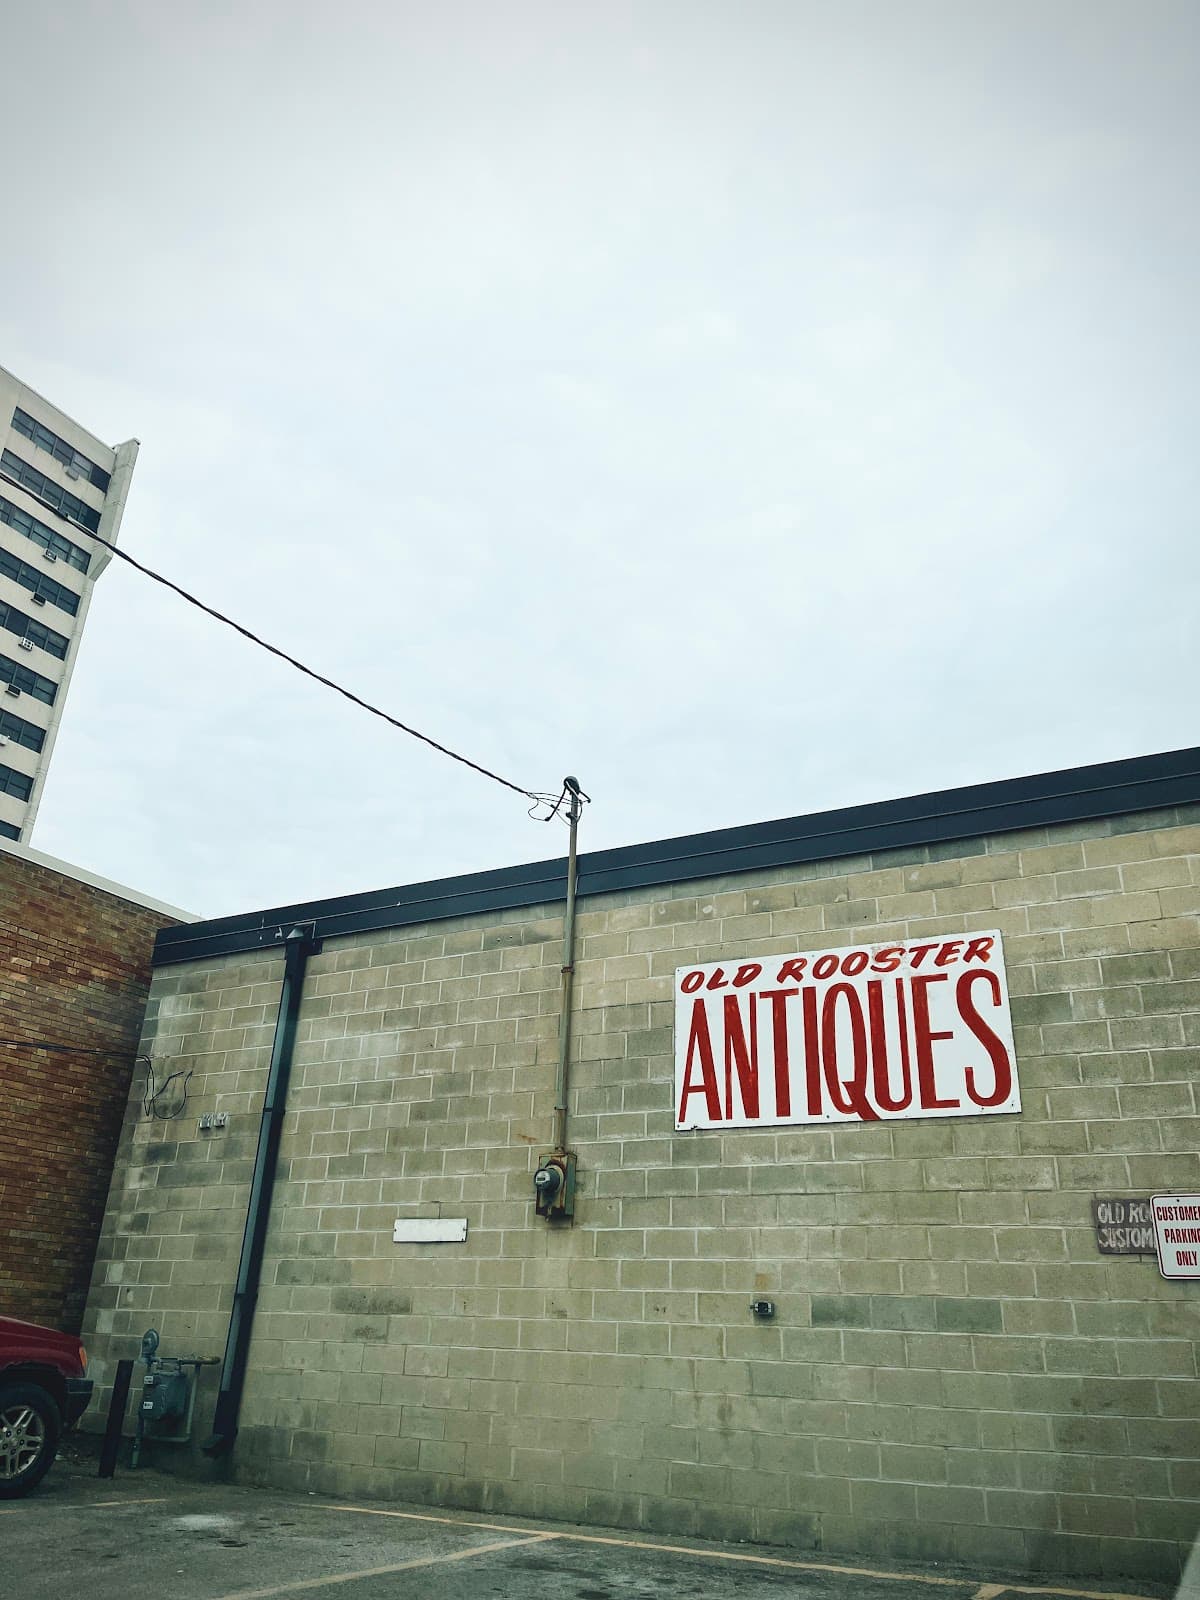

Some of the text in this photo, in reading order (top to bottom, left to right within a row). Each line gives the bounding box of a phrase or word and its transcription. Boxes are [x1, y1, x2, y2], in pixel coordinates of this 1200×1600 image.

[680, 936, 995, 994] OLD ROOSTER
[678, 968, 1012, 1123] ANTIQUES
[1097, 1202, 1125, 1224] OLD
[1098, 1227, 1157, 1248] CUSTOM
[1176, 1251, 1197, 1266] ONLY
